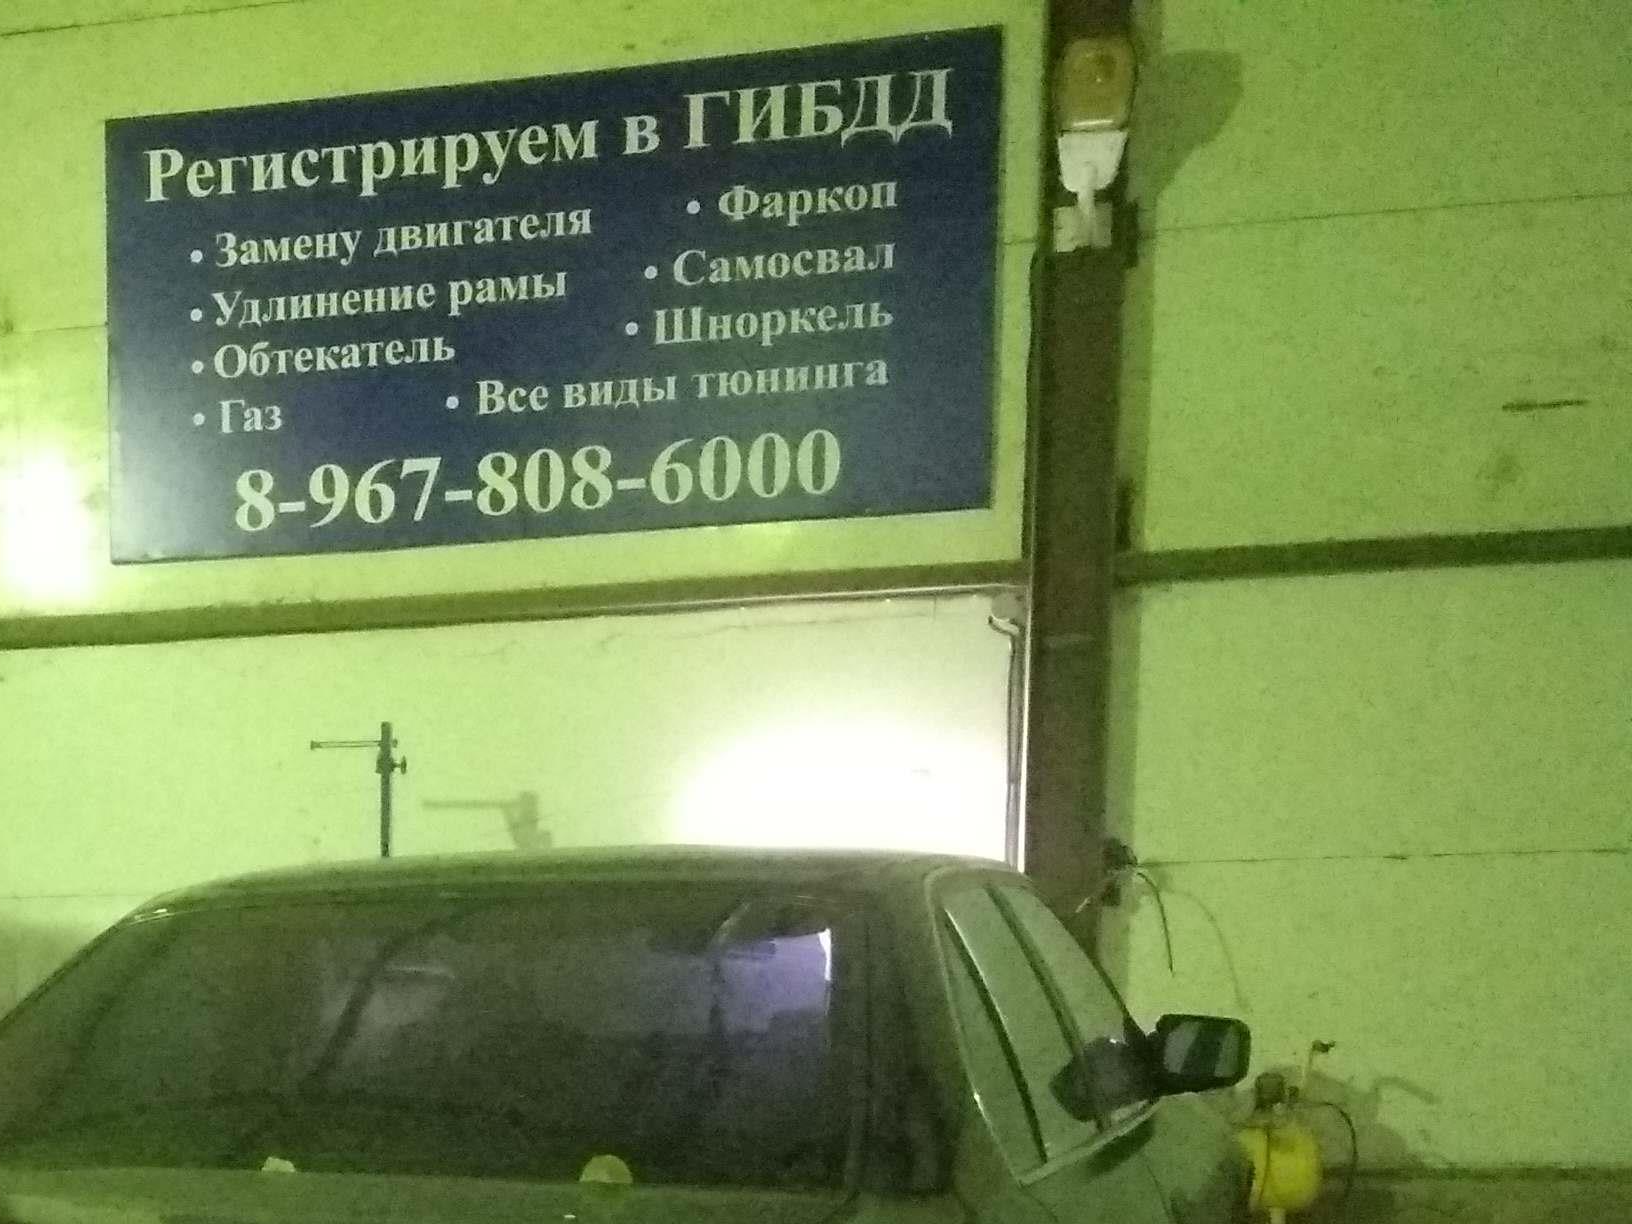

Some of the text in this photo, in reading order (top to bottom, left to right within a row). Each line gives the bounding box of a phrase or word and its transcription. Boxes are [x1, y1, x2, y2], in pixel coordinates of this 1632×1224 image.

[143, 67, 954, 202] Регистрируем в ГИБДД
[718, 181, 898, 227] Фаркоп
[215, 207, 593, 268] Замену двигателя
[673, 242, 896, 287] Самосвал
[211, 271, 568, 328] Удлинение рамы
[654, 300, 895, 346] Шноркель
[214, 336, 456, 379] Обтекатель
[476, 359, 889, 416] Все виды тюнинга
[219, 399, 284, 435] Газ
[234, 429, 841, 532] 8-967-808-6000
